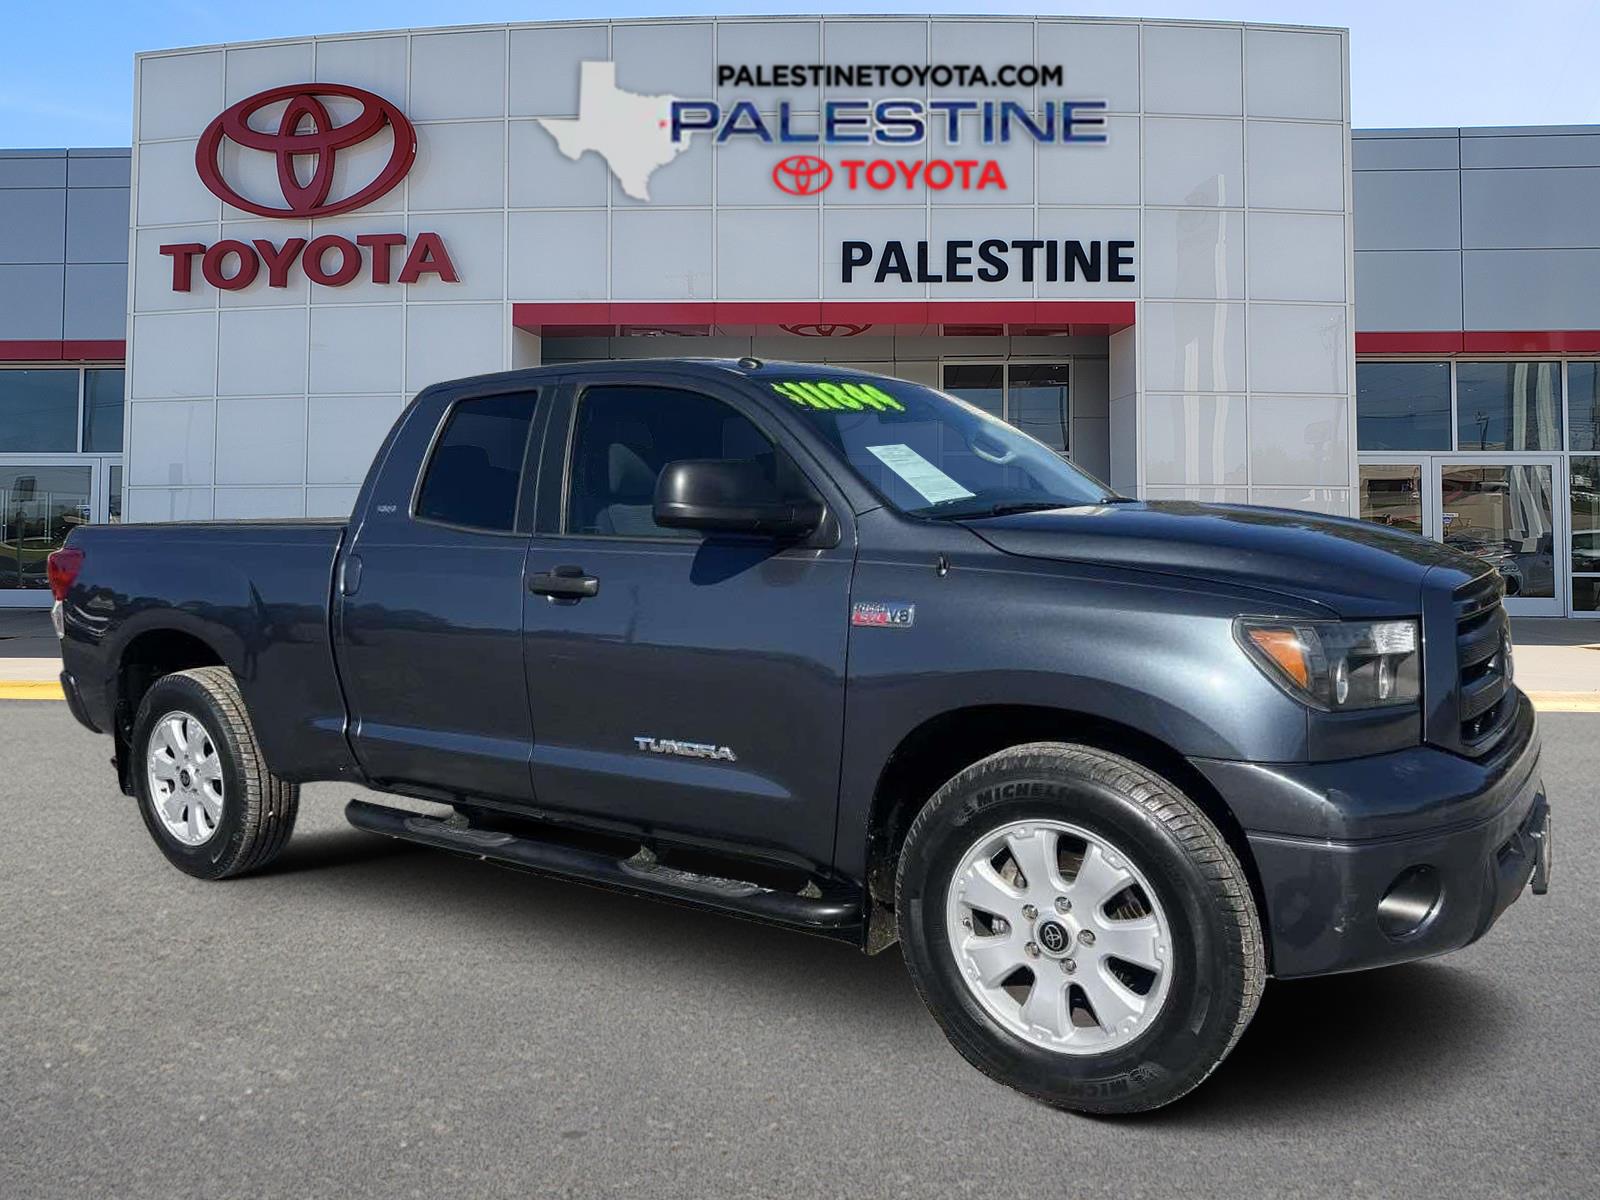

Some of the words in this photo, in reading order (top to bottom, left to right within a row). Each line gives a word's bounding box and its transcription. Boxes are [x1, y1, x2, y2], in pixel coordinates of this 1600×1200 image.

[159, 231, 461, 292] TOYOTA
[841, 239, 1136, 283] PALESTINE
[633, 736, 737, 761] TUNDRA
